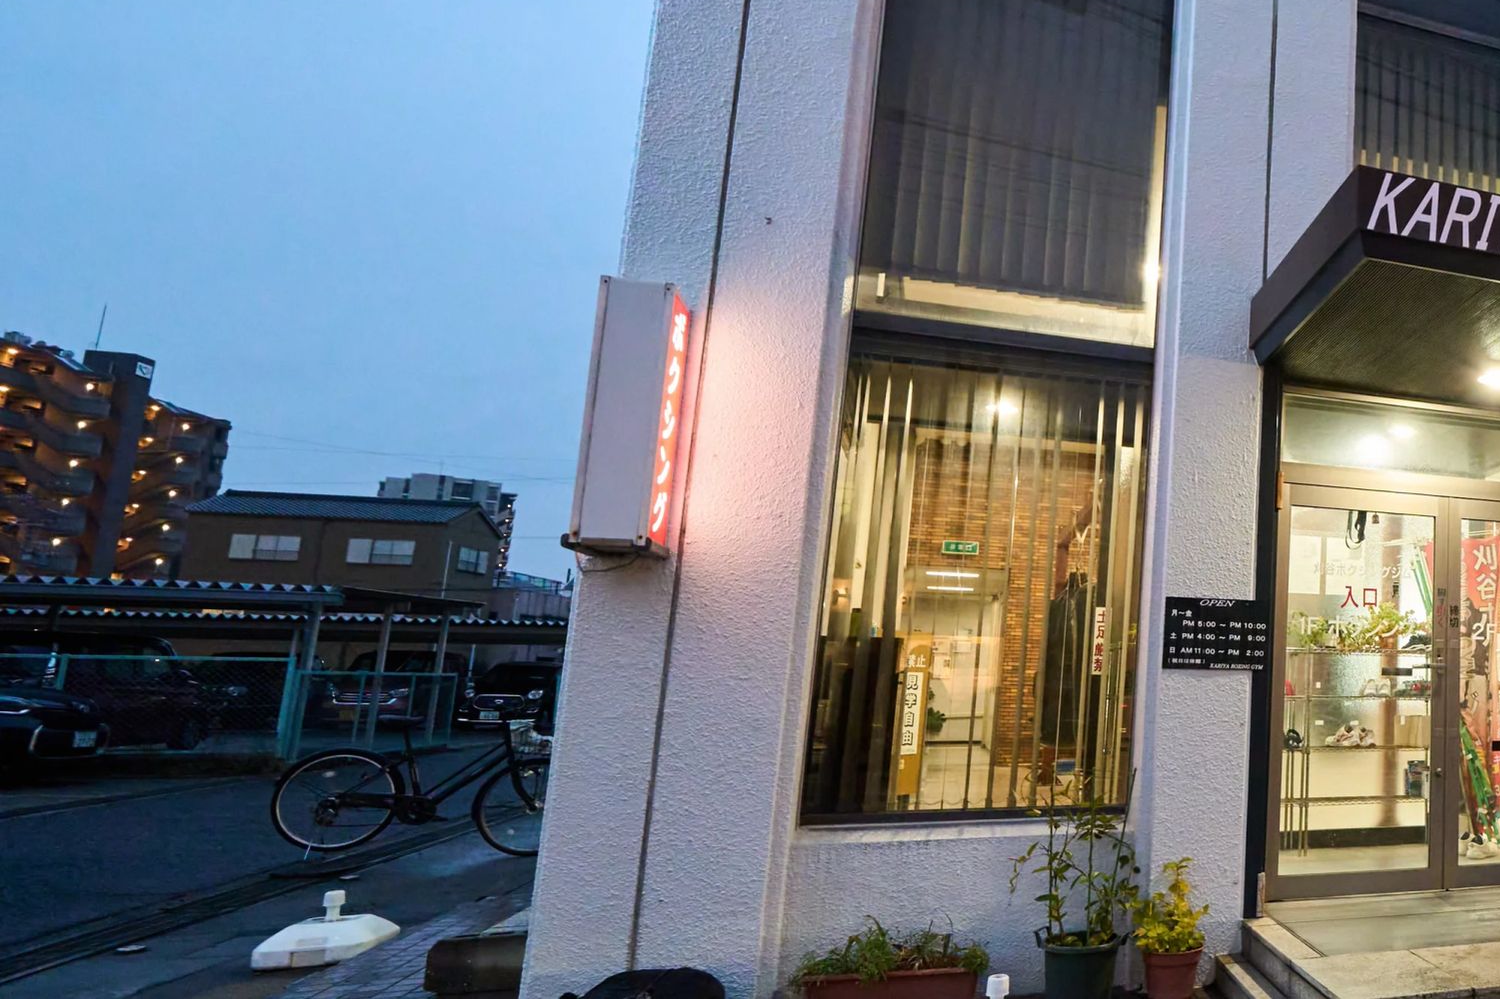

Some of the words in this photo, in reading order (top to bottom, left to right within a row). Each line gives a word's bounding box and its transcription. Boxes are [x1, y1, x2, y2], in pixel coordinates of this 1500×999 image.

[1199, 599, 1236, 607] OPEN
[1341, 585, 1378, 608] 入口
[1181, 632, 1194, 640] PM
[902, 674, 918, 746] 見学自由
